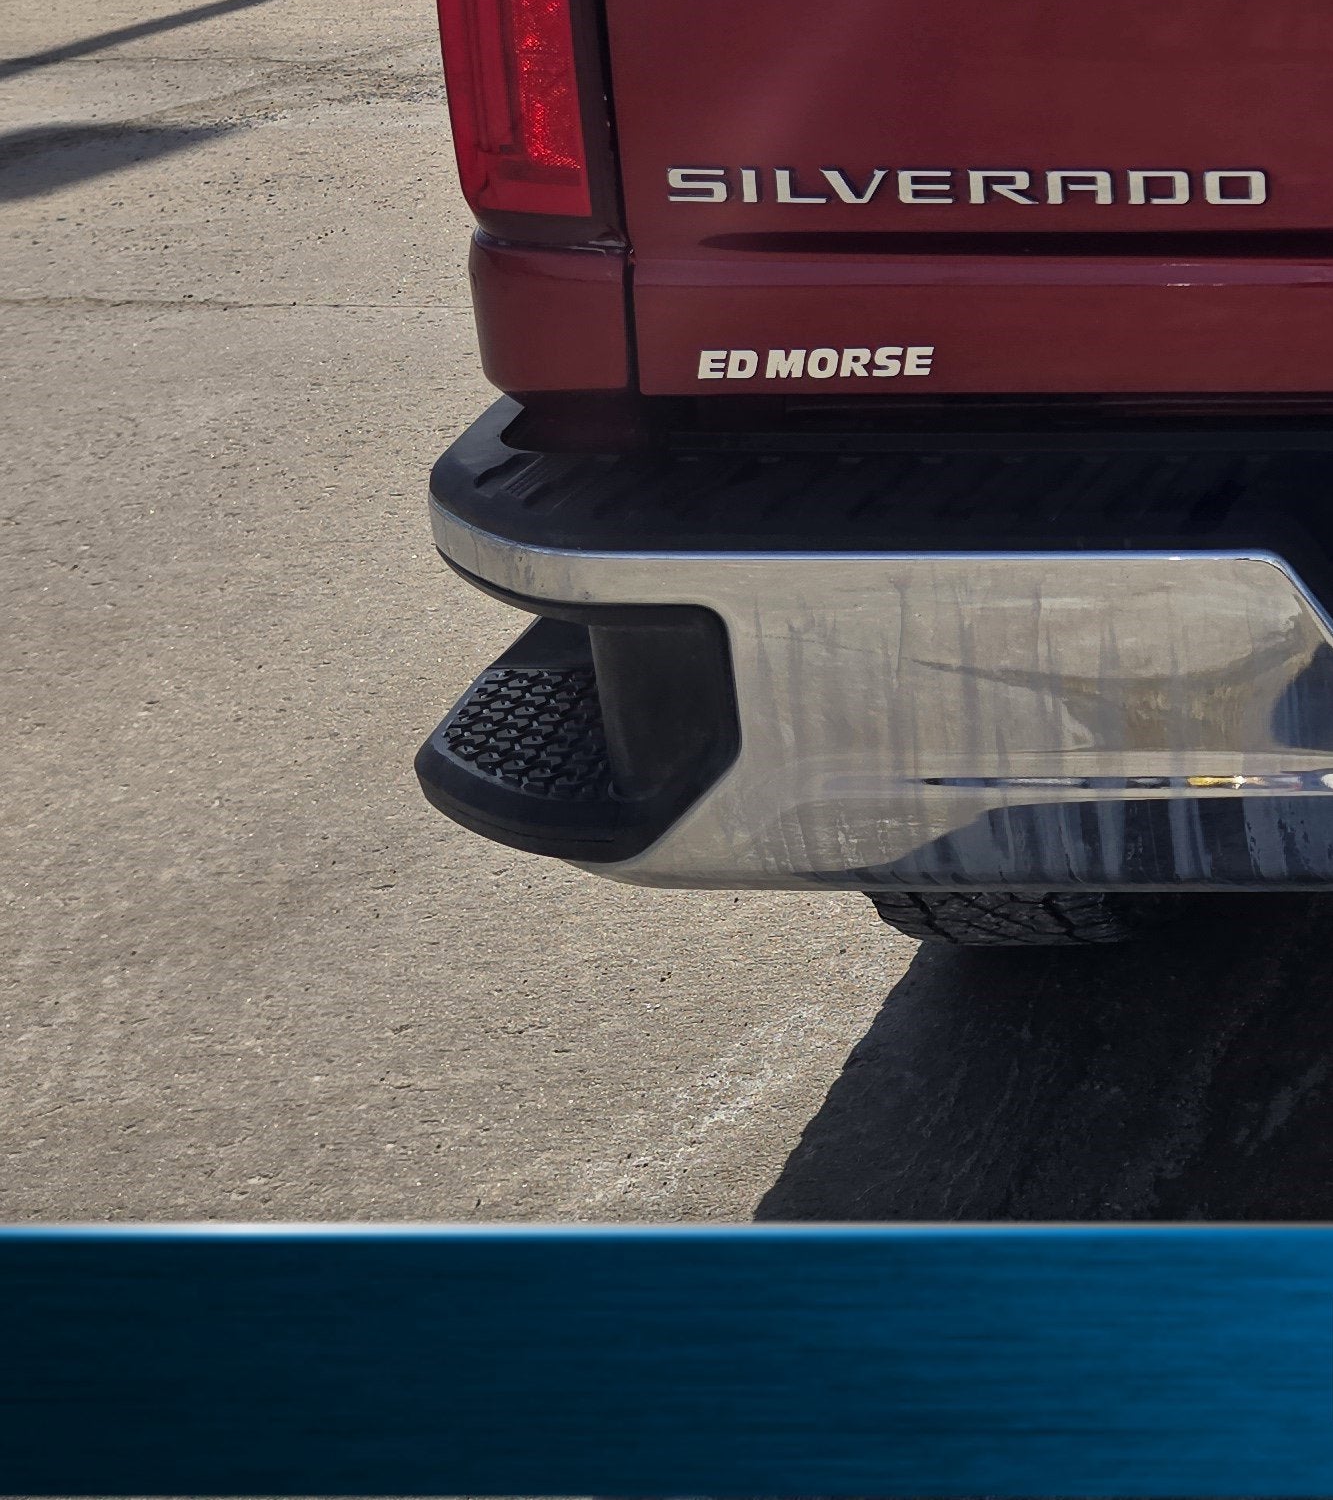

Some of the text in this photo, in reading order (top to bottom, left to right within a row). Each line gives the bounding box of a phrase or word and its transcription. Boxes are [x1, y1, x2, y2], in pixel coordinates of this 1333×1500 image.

[666, 168, 1268, 206] SILVERADO
[697, 346, 935, 380] ED MORSE
